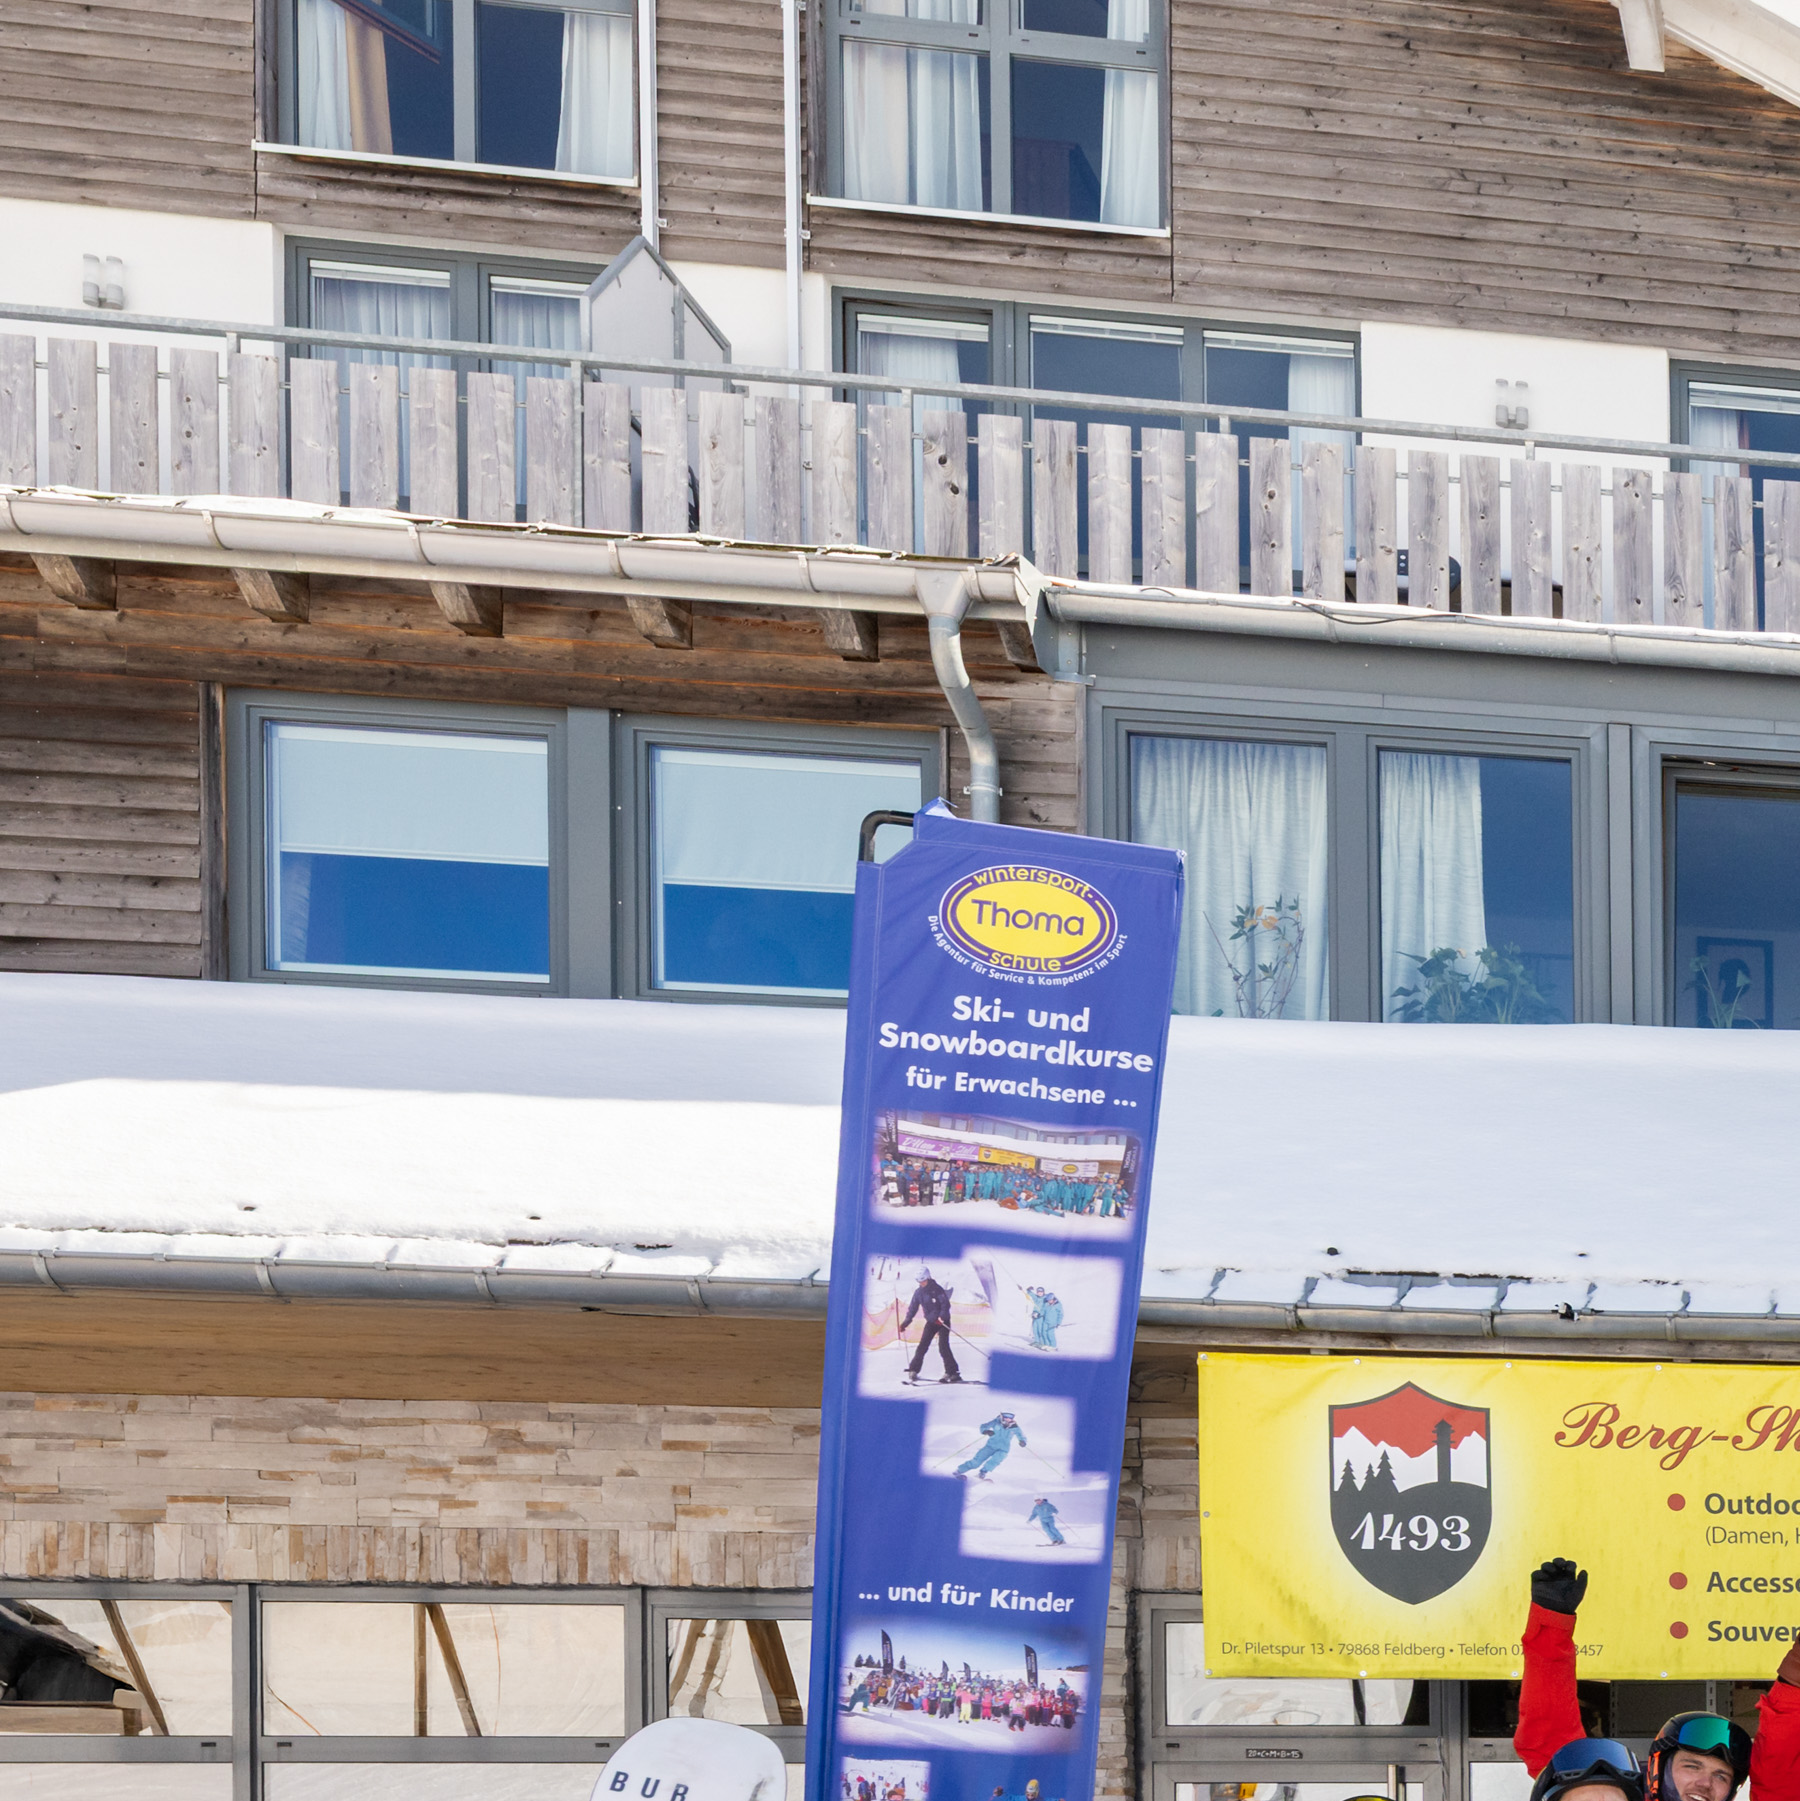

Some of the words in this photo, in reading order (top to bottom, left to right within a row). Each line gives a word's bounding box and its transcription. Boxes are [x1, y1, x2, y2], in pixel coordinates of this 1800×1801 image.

[973, 866, 1093, 899] wintersport-
[971, 899, 1085, 936] Thoma
[928, 915, 938, 932] Die
[934, 932, 970, 966] Agentur
[971, 961, 988, 976] für
[988, 968, 1024, 984] Service
[1027, 976, 1035, 985] &
[1038, 967, 1095, 986] Kompetenz
[1094, 958, 1109, 970] im
[1107, 934, 1128, 960] Sport
[989, 951, 1061, 971] schule
[951, 995, 1015, 1022] Ski-
[1027, 1007, 1090, 1033] und
[878, 1022, 1154, 1073] Snowboardkurse
[906, 1065, 947, 1090] für
[955, 1071, 1106, 1105] Erwachsene
[1350, 1510, 1472, 1552] 1493
[1705, 1526, 1788, 1547] (Damen,
[888, 1582, 932, 1604] und
[940, 1582, 981, 1607] für
[990, 1588, 1075, 1613] Kinder
[1222, 1642, 1241, 1655] Dr.
[1245, 1642, 1305, 1657] Piletspur
[1311, 1643, 1325, 1655] 13
[1338, 1643, 1380, 1655] 79868
[1384, 1642, 1445, 1658] Feldberg
[1458, 1643, 1507, 1656] Telefon
